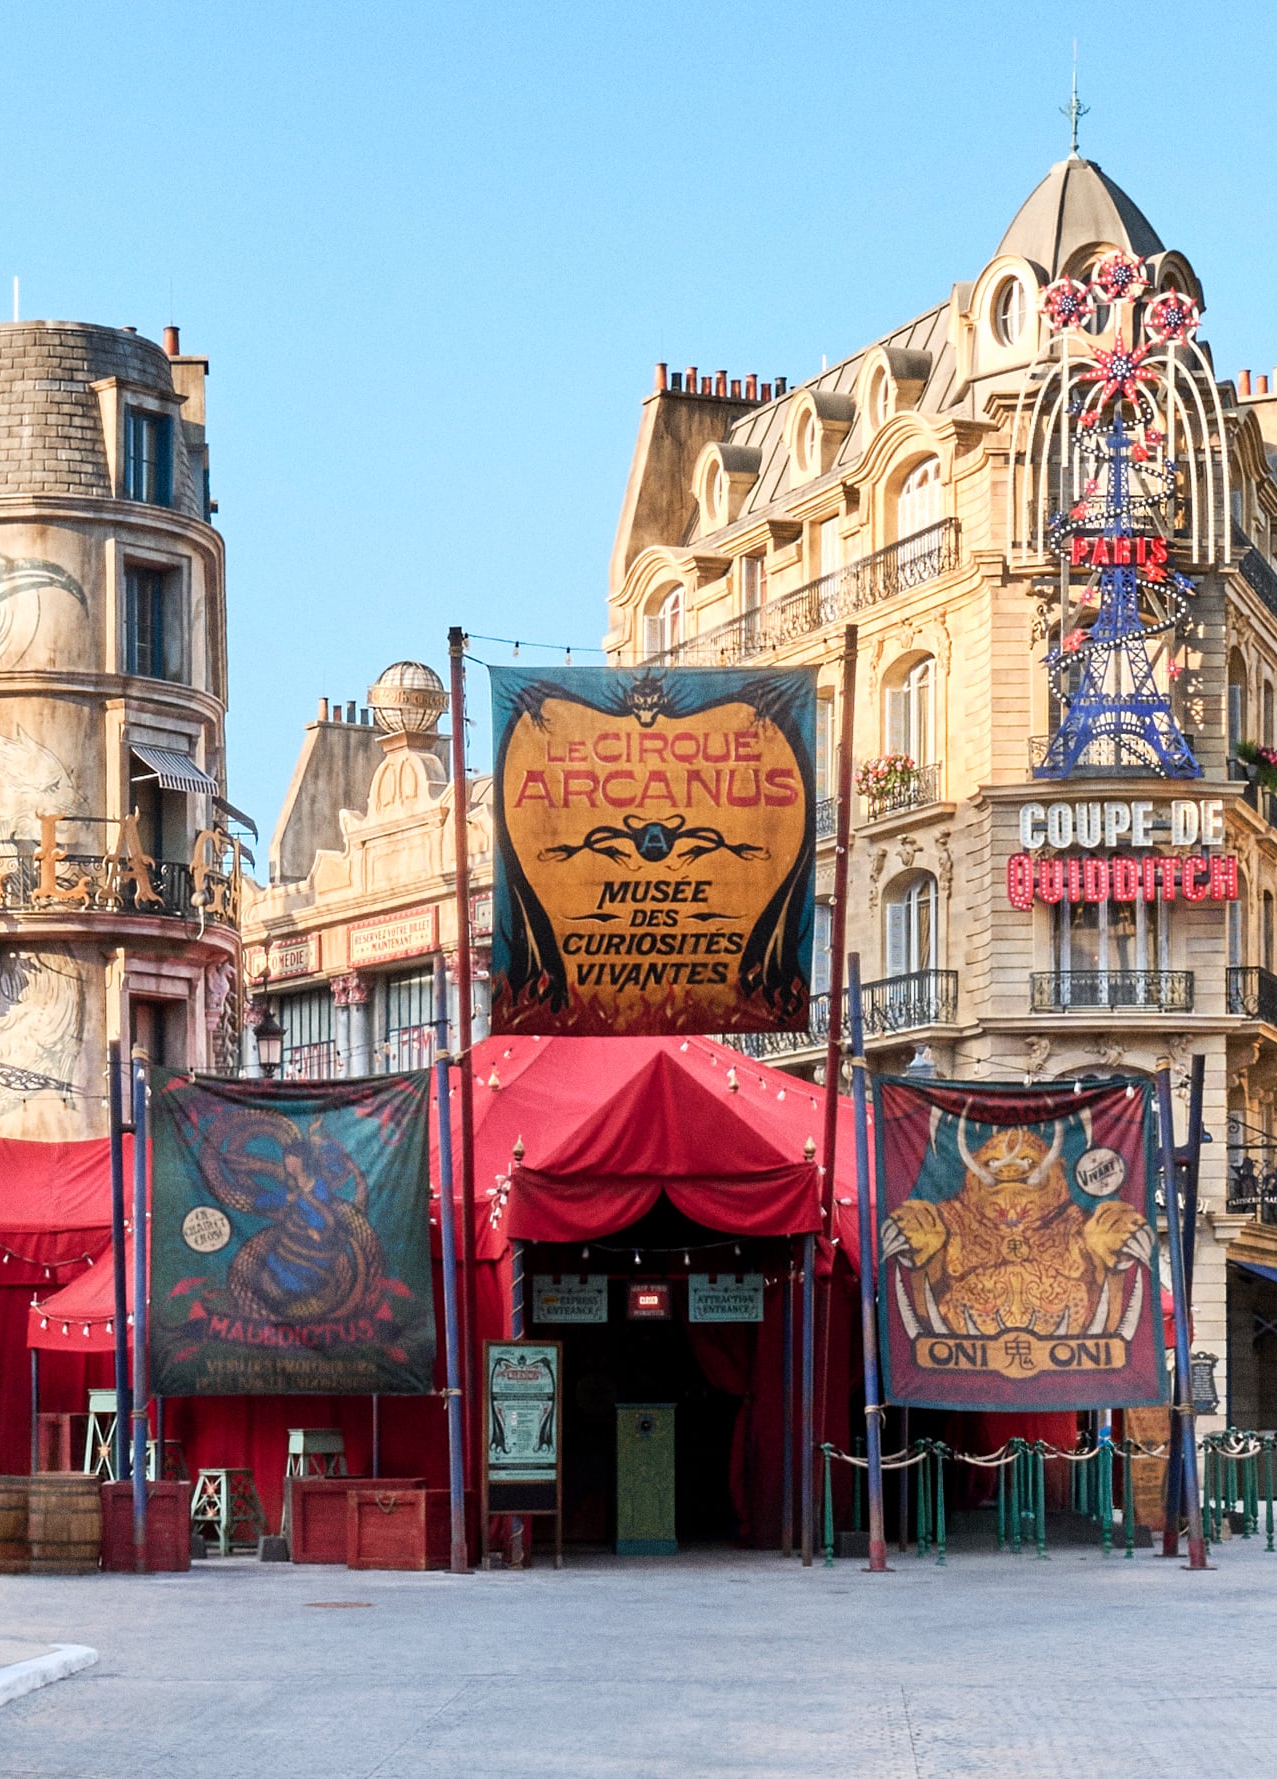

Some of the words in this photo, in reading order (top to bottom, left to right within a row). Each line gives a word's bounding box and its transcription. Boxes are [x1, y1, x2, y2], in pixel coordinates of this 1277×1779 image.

[1071, 536, 1169, 565] PARIS
[547, 741, 587, 763] LE
[593, 732, 762, 765] CIRQUE
[513, 768, 800, 808] ARCANUS
[1018, 801, 1154, 849] COUPE
[1170, 800, 1224, 847] DE
[29, 803, 165, 911] LA
[596, 875, 713, 909] MUSÉE
[1006, 852, 1239, 911] QUIDDITCH
[409, 918, 430, 934] BILLET
[628, 909, 680, 928] DES
[372, 934, 413, 950] MAINTENANT
[561, 927, 745, 956] CURIOSITÉS
[575, 962, 730, 993] VIVANTES
[928, 1340, 988, 1367] ONI
[1003, 1337, 1036, 1371] 鬼
[1048, 1338, 1114, 1366] ONI
